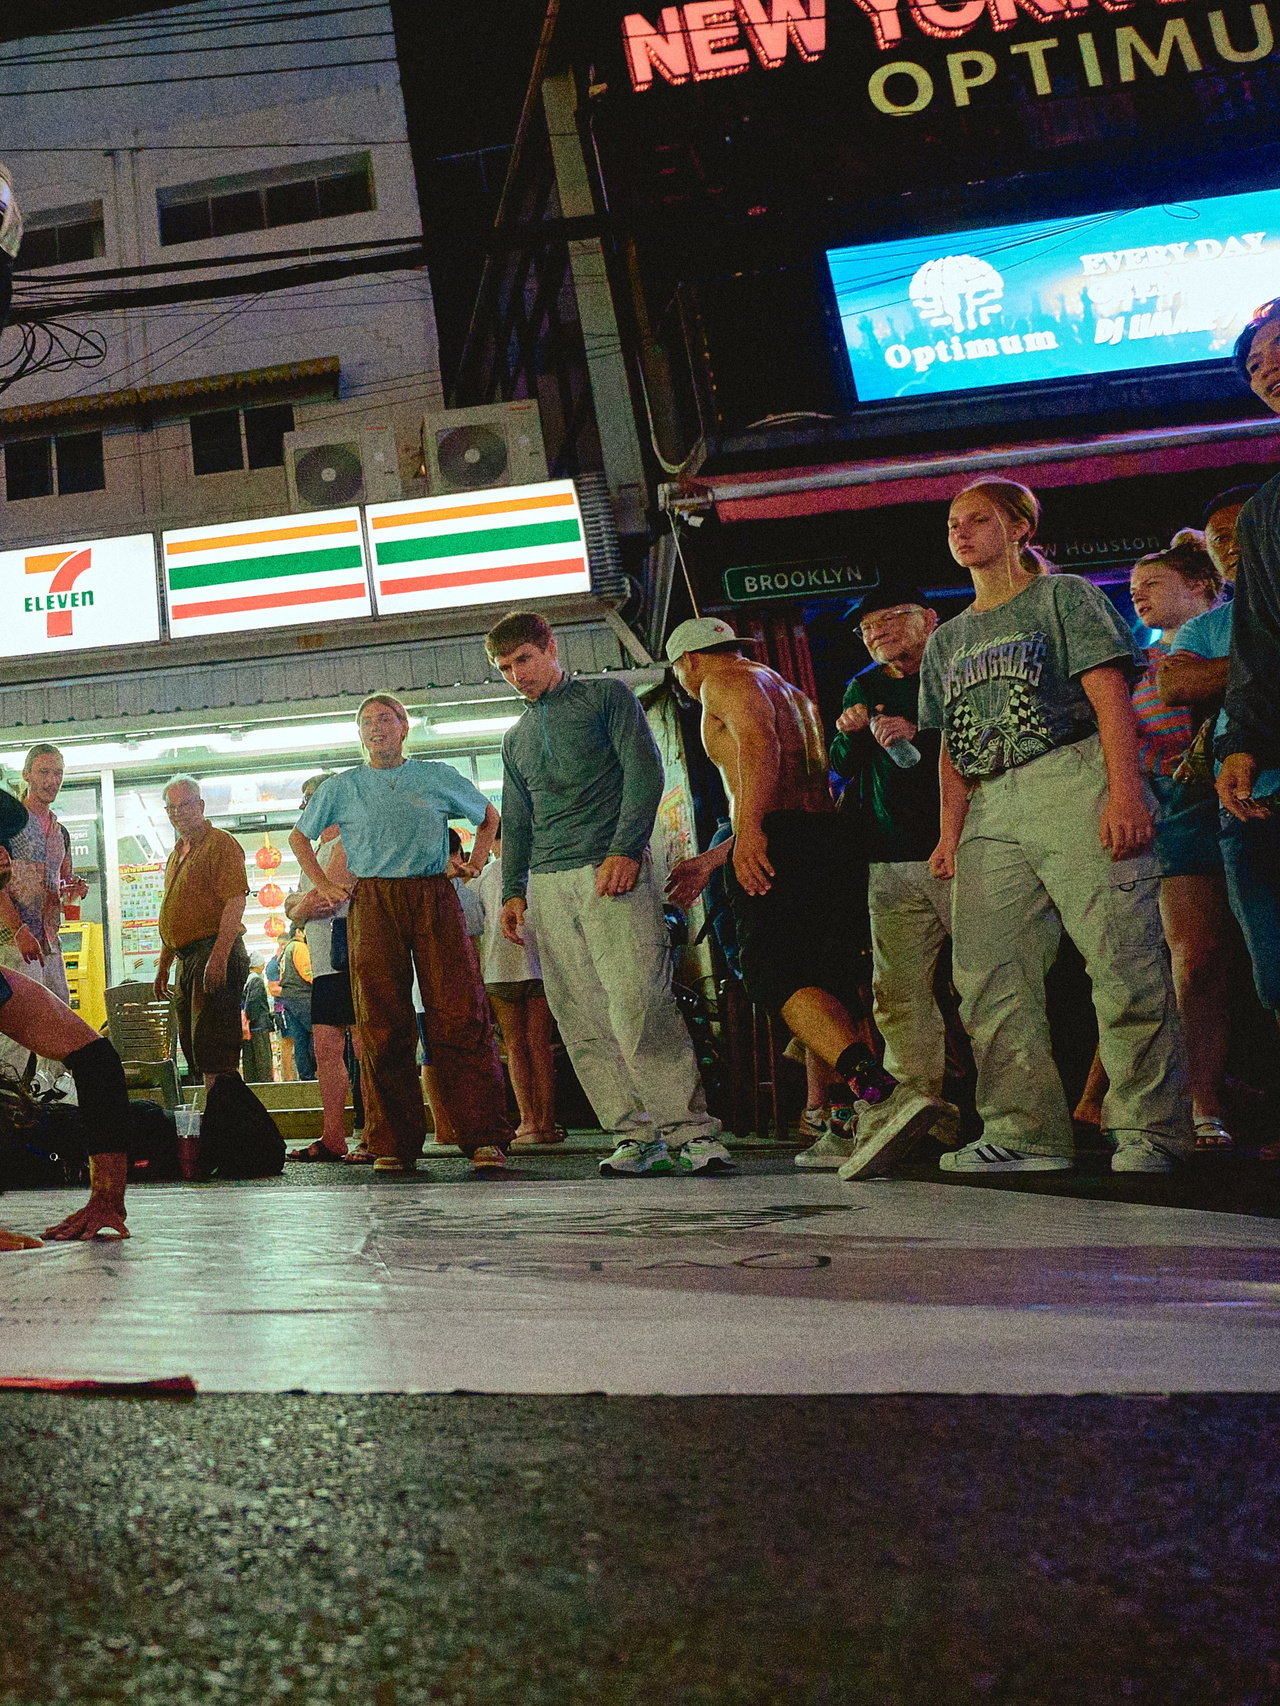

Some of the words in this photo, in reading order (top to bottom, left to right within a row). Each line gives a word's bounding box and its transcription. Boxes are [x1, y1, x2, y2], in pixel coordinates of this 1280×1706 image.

[623, 0, 826, 92] NEW
[867, 3, 1274, 116] OPTIMU
[1080, 242, 1190, 276] EVERY
[1195, 232, 1266, 261] DAY
[884, 330, 1059, 373] Optimum
[24, 547, 92, 638] 7
[744, 566, 862, 593] BROOKLYN
